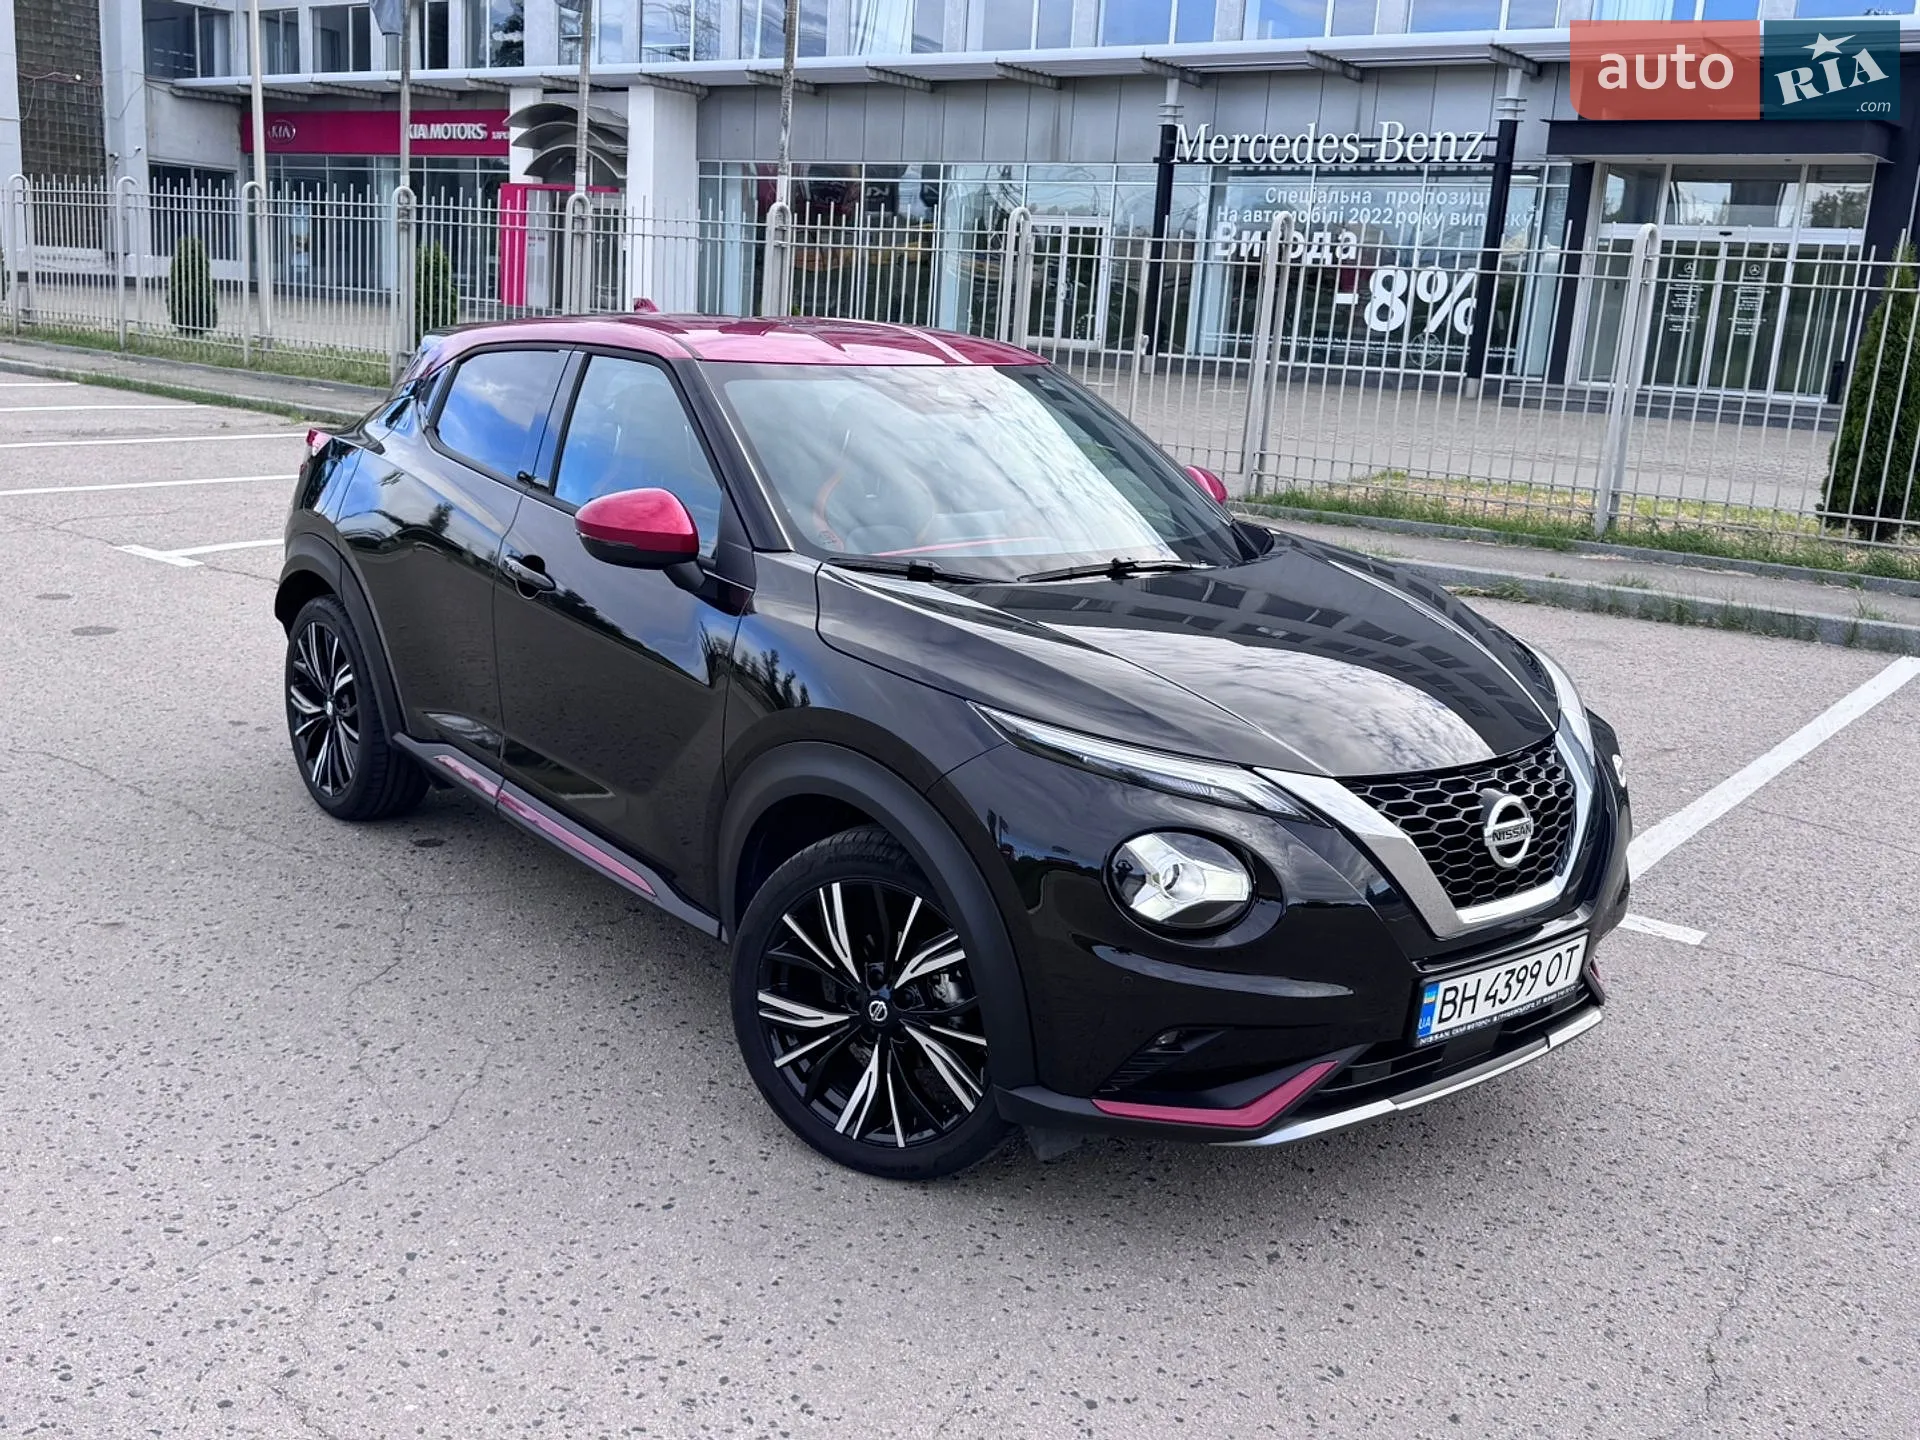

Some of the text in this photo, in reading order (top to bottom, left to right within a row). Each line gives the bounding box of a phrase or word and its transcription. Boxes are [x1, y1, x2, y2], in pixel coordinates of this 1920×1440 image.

[271, 125, 291, 139] KIA
[429, 123, 486, 140] MOTORS
[1170, 121, 1487, 164] Mercedes-Benz
[1265, 187, 1491, 208] Спеціальна пропозиці
[1216, 206, 1238, 222] На
[1348, 207, 1393, 226] 2022
[1395, 210, 1444, 229] року
[1336, 265, 1478, 335] -8%
[1492, 823, 1532, 842] NISSAN
[1438, 979, 1481, 1024] BH
[1484, 960, 1543, 1009] 4399
[1545, 945, 1580, 987] OT
[1418, 1016, 1432, 1030] UA
